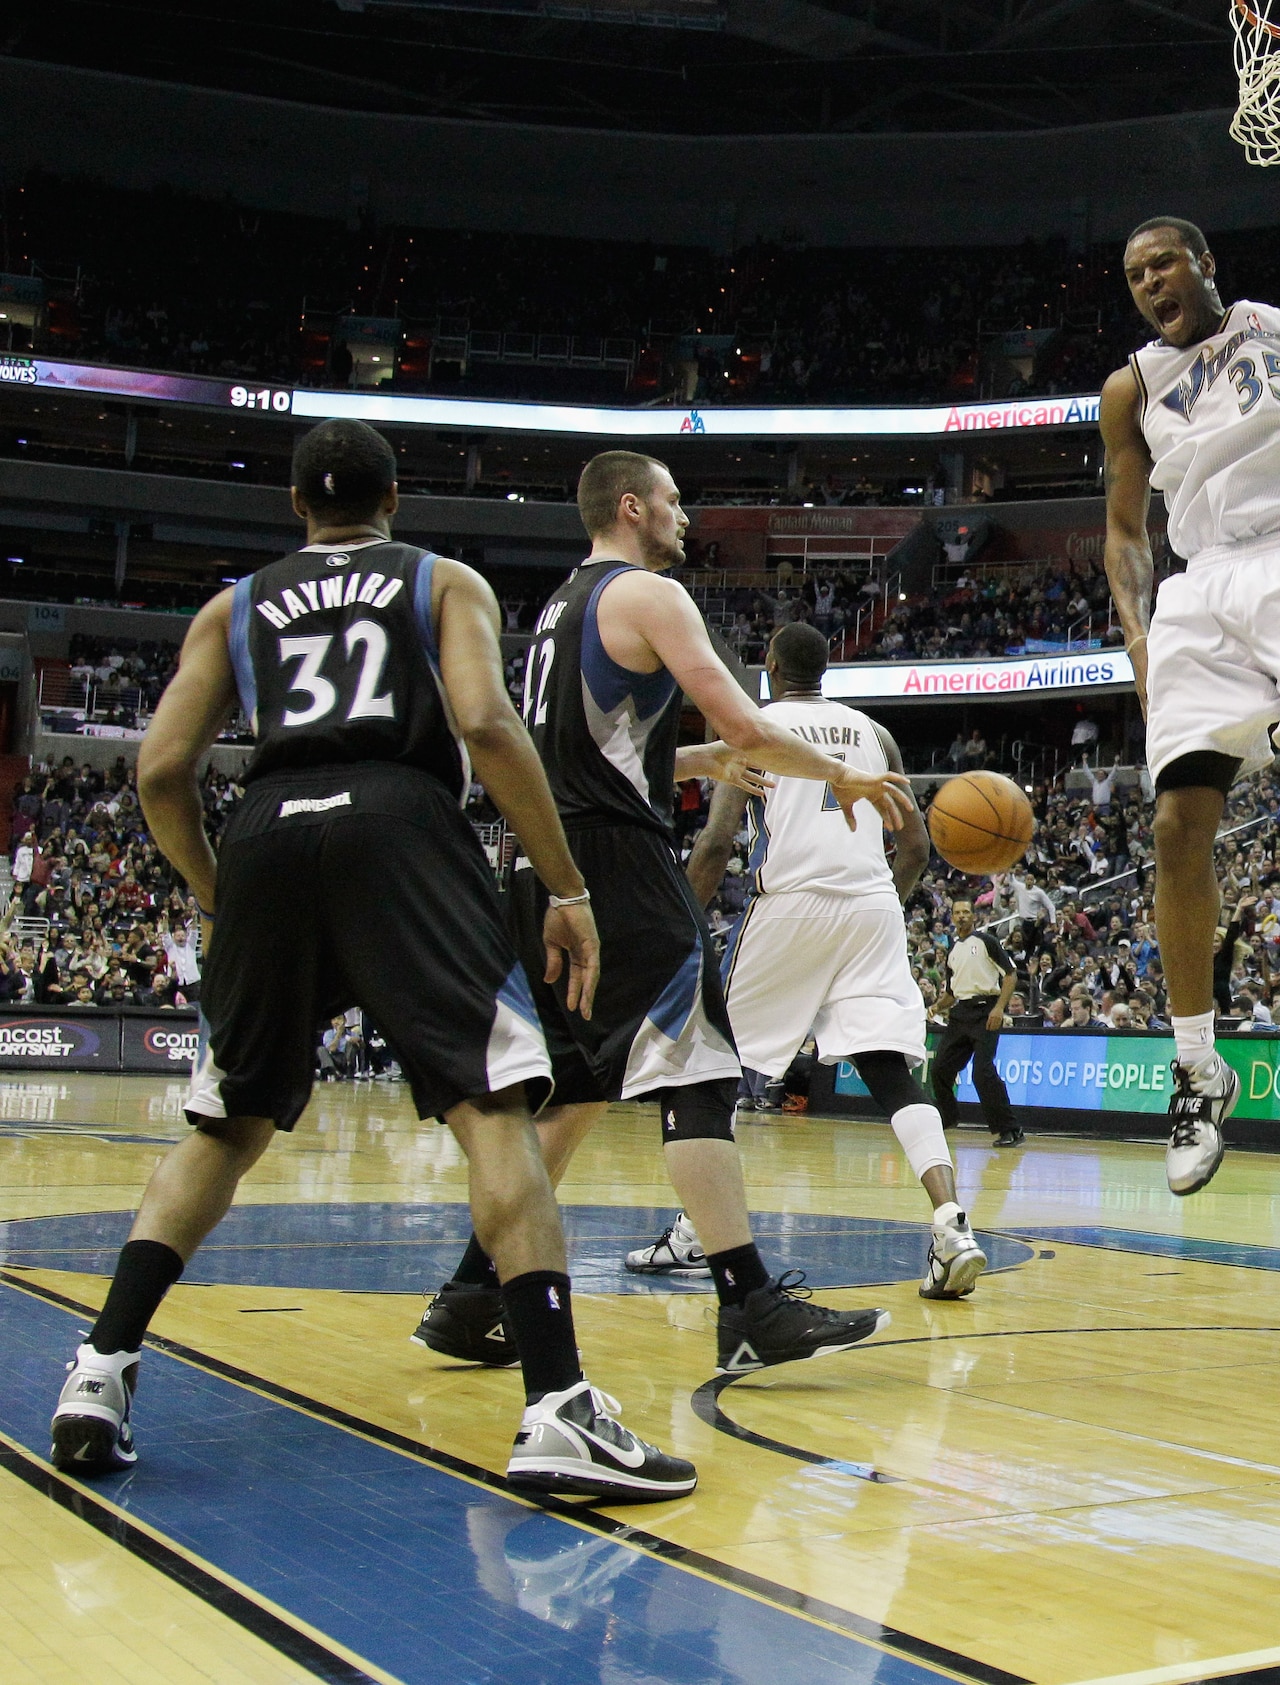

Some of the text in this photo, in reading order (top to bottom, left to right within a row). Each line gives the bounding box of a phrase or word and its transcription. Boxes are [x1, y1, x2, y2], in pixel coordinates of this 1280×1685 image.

[230, 386, 290, 411] 9:10
[35, 607, 59, 619] 104
[256, 572, 404, 630] HAYWARD
[279, 619, 396, 727] 32
[1049, 1061, 1077, 1086] OF
[1083, 1063, 1166, 1091] PEOPLE
[1175, 1097, 1204, 1114] NIKE
